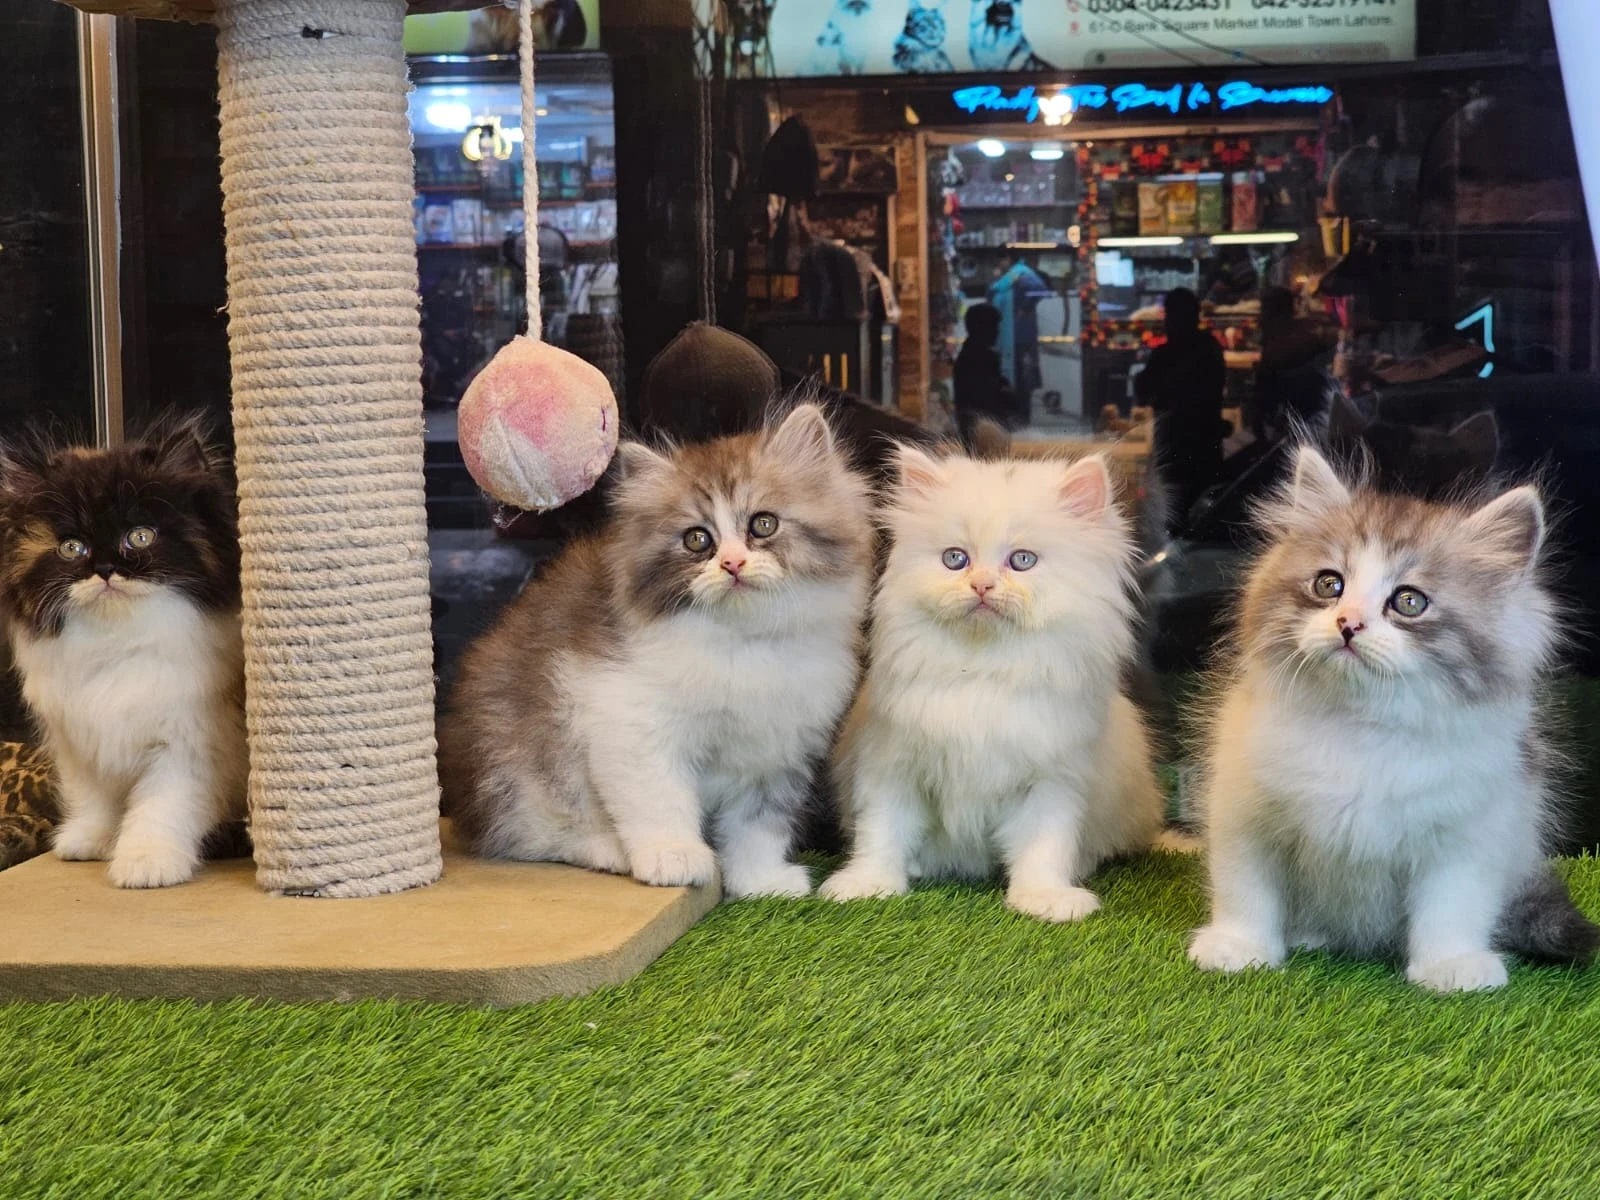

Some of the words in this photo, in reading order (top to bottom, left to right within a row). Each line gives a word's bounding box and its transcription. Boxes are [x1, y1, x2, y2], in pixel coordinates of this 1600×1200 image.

[1213, 17, 1258, 30] Market
[1262, 15, 1302, 29] Model
[1307, 15, 1341, 27] Town
